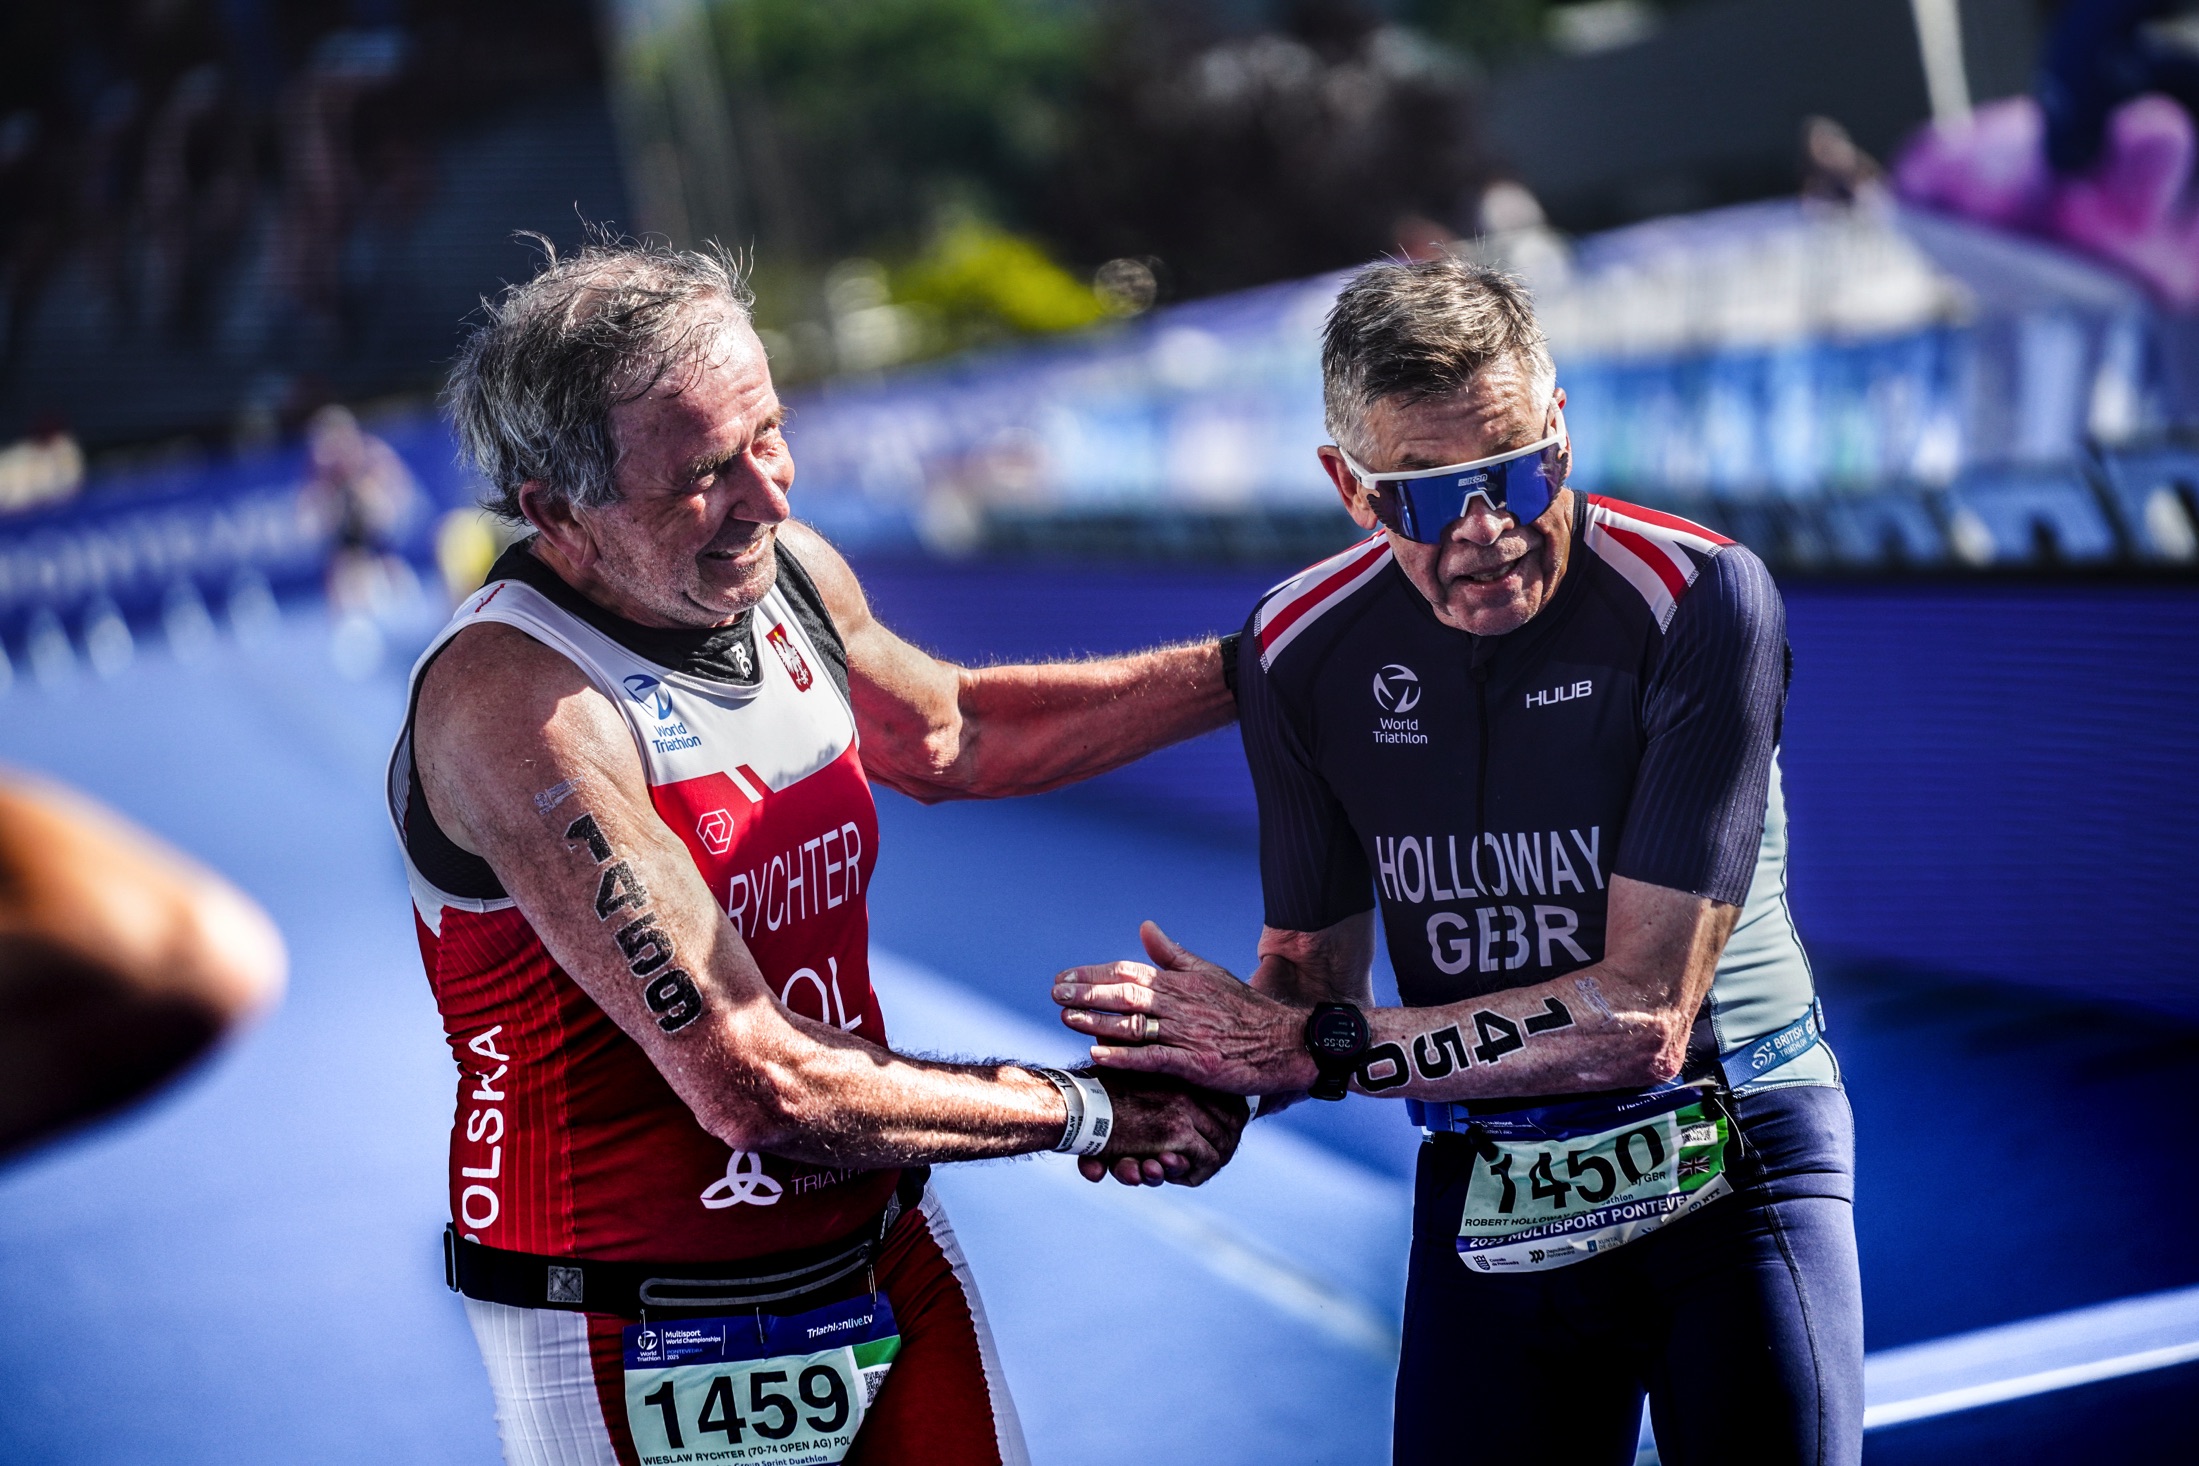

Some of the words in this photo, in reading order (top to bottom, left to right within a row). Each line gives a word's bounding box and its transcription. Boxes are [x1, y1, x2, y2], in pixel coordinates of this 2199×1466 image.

[1526, 680, 1593, 709] HUUB
[654, 722, 687, 738] World
[1373, 730, 1428, 744] Triathlon
[1380, 717, 1419, 731] World
[652, 734, 701, 754] Triathlon
[1376, 826, 1604, 904] HOLLOWAY
[726, 821, 863, 939] RYCHTER
[562, 812, 704, 1036] 1459
[1426, 905, 1592, 975] GBR
[781, 956, 864, 1033] OL
[1354, 996, 1576, 1093] 1450
[1773, 1024, 1804, 1050] BRITISH
[461, 1025, 510, 1244] OLSKA
[1490, 1125, 1665, 1214] 1450
[1643, 1171, 1667, 1183] GBR
[1601, 1193, 1634, 1206] athlon
[1703, 1188, 1721, 1204] NTT
[1465, 1218, 1509, 1227] ROBERT
[1508, 1211, 1607, 1242] MULTISPORT
[665, 1329, 702, 1339] Multisport
[807, 1313, 874, 1340] Triathlonlive.tv
[666, 1338, 682, 1346] World
[683, 1336, 722, 1345] Championships
[637, 1355, 661, 1363] Triathlon
[644, 1364, 850, 1450] 1459
[642, 1453, 693, 1466] WIESLAW
[696, 1449, 746, 1462] RYCHTER
[748, 1444, 778, 1458] (70-74
[780, 1440, 811, 1454] OPEN
[813, 1437, 832, 1450] AG)
[834, 1436, 851, 1448] POL
[789, 1454, 828, 1465] Duathlon
